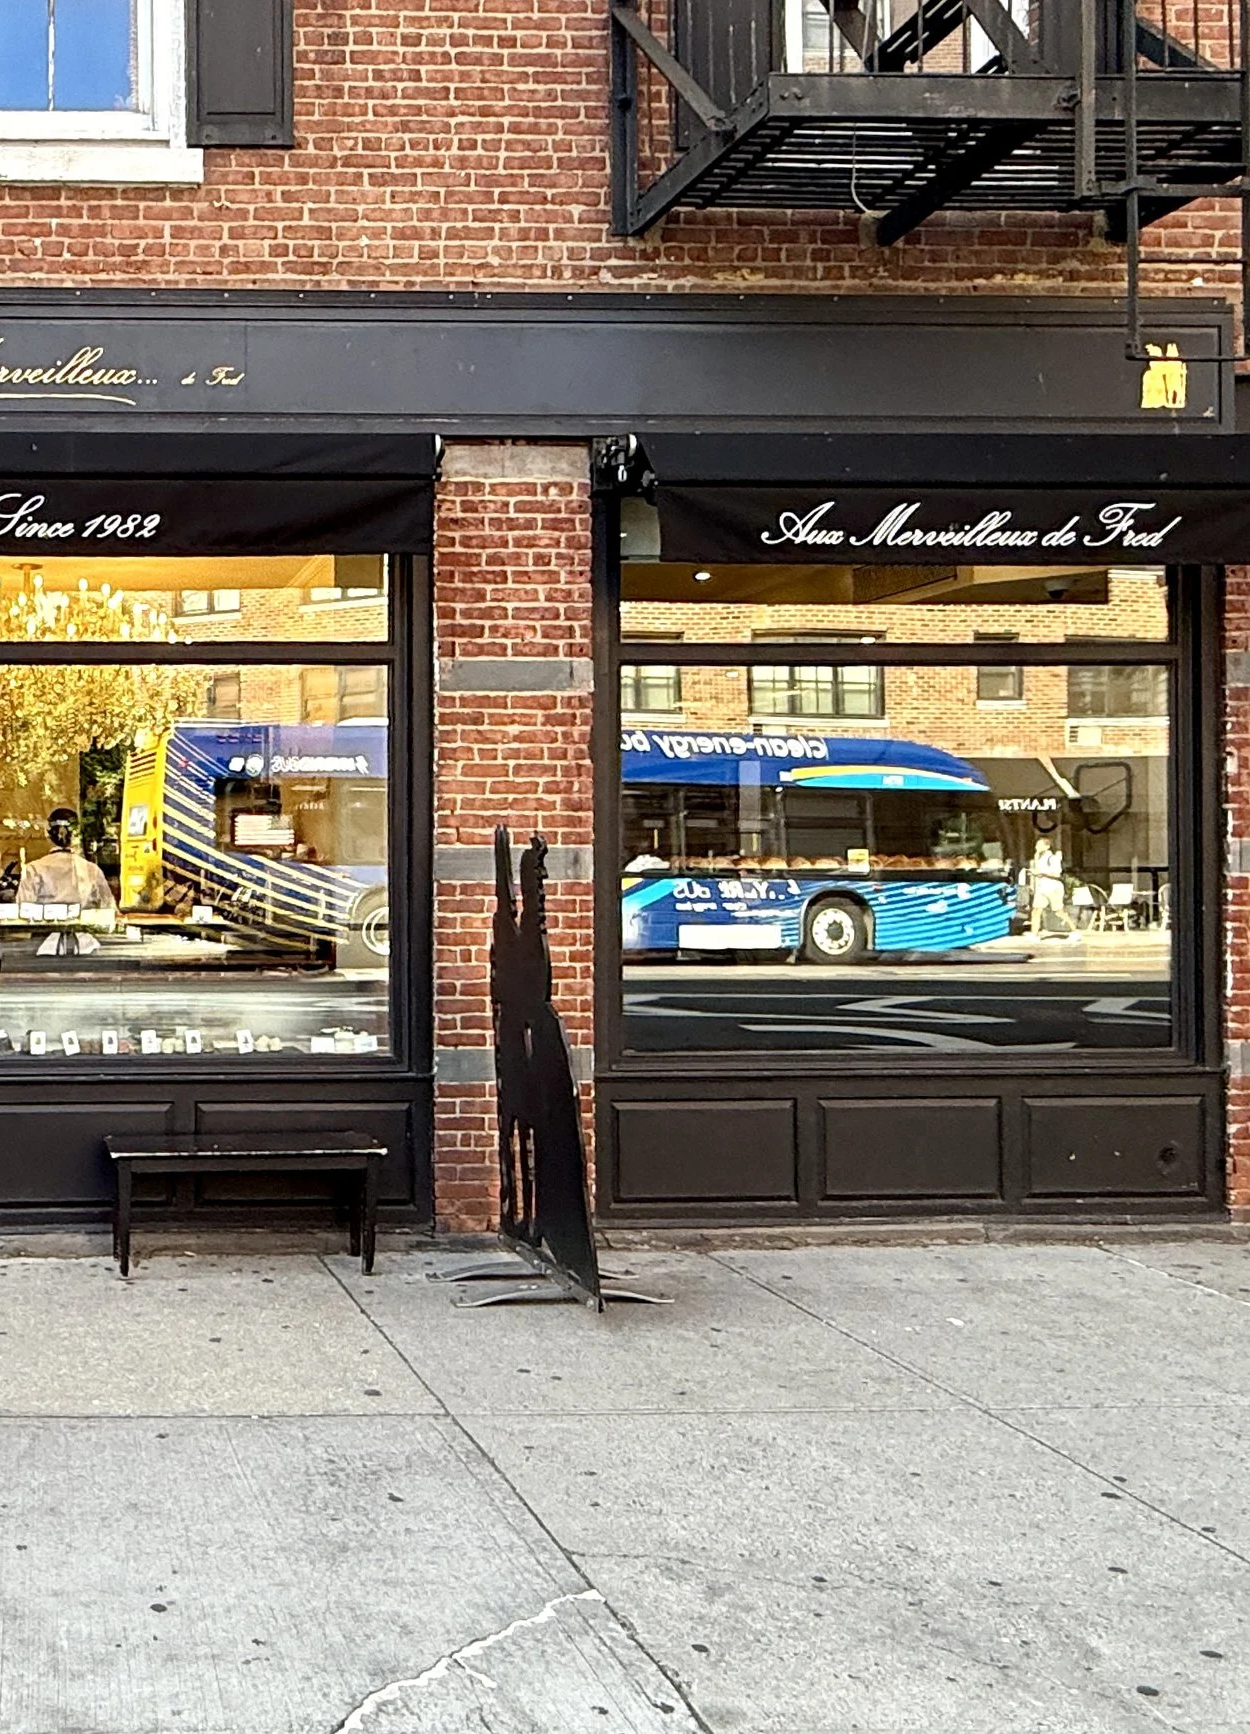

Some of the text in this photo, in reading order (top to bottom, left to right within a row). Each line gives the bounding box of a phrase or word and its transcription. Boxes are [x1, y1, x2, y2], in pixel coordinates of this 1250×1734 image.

[81, 513, 161, 538] 1982
[760, 501, 1182, 547] Aux Merveilleux de Fred
